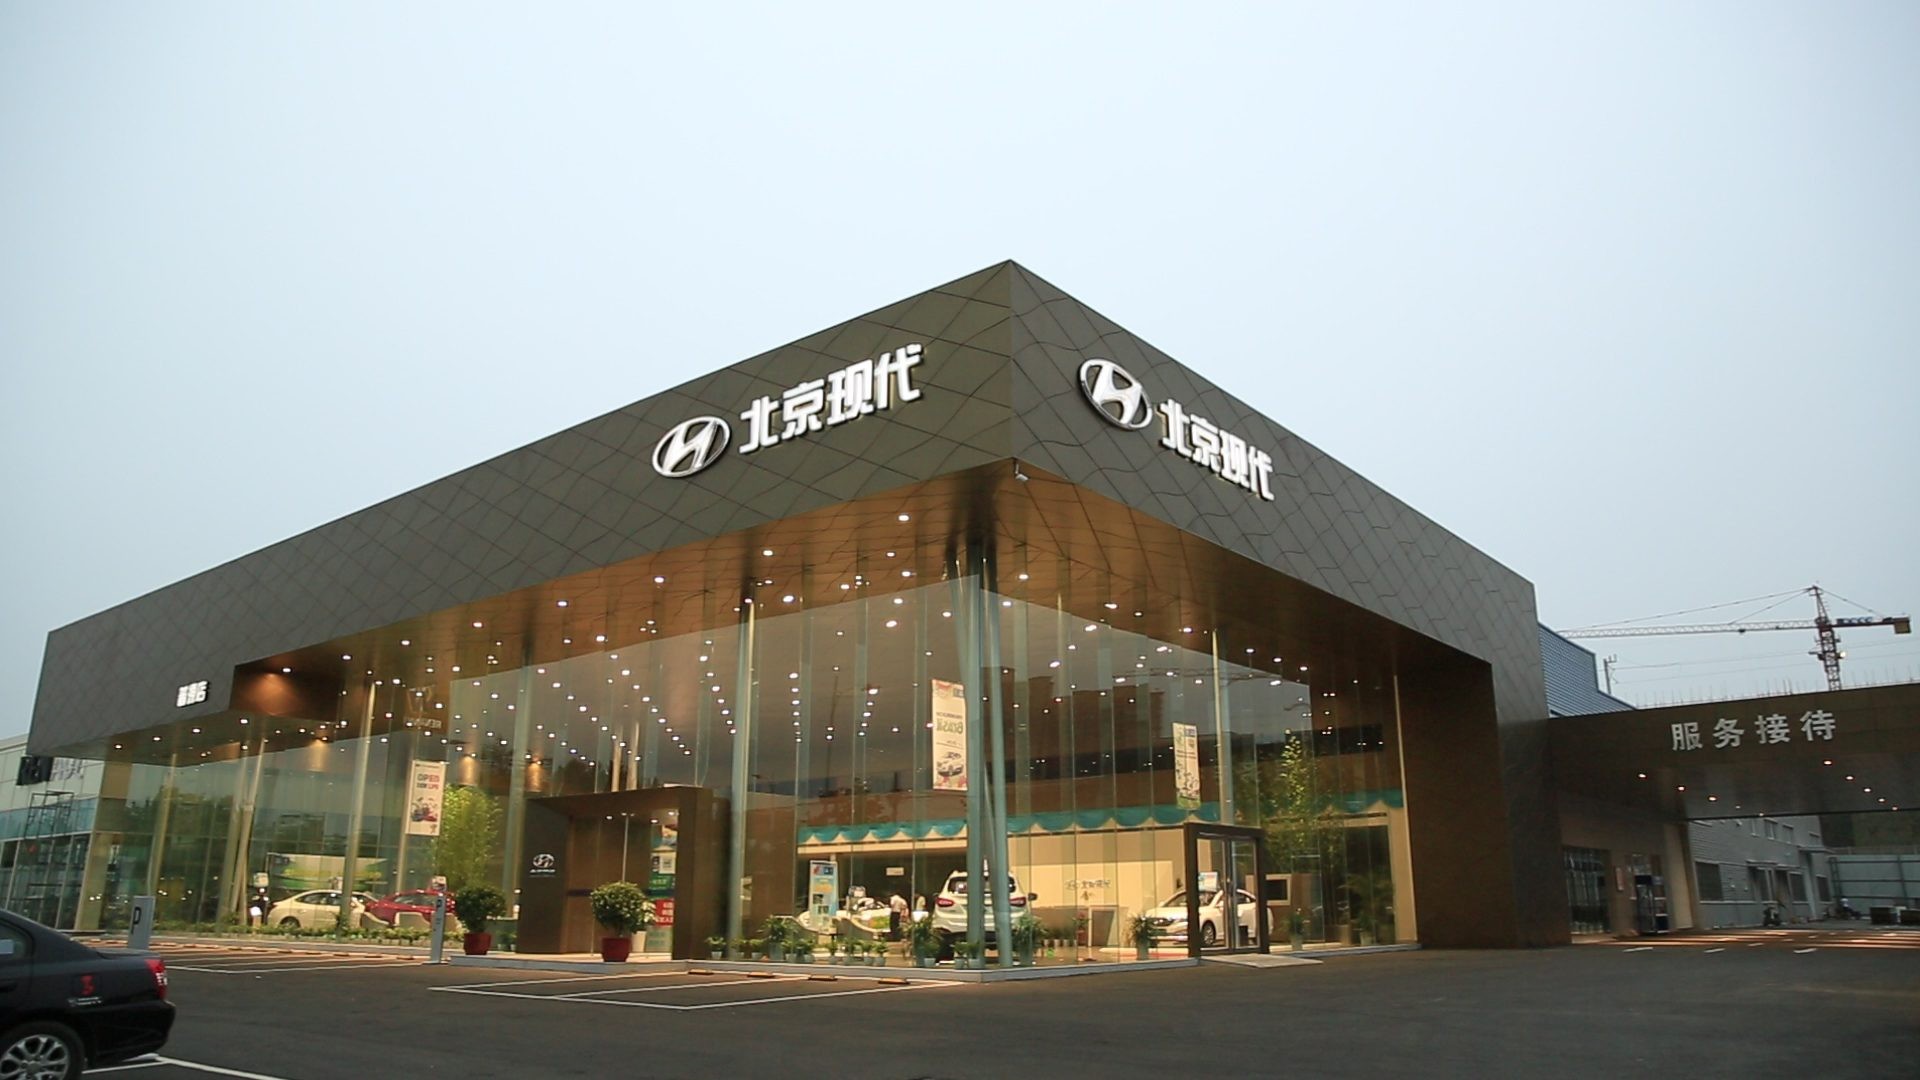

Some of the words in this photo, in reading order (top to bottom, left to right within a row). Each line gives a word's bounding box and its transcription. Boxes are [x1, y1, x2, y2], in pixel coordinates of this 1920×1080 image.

[739, 343, 923, 454] 北京现代
[1160, 398, 1275, 501] 北京现代
[1671, 709, 1837, 751] 服务接待
